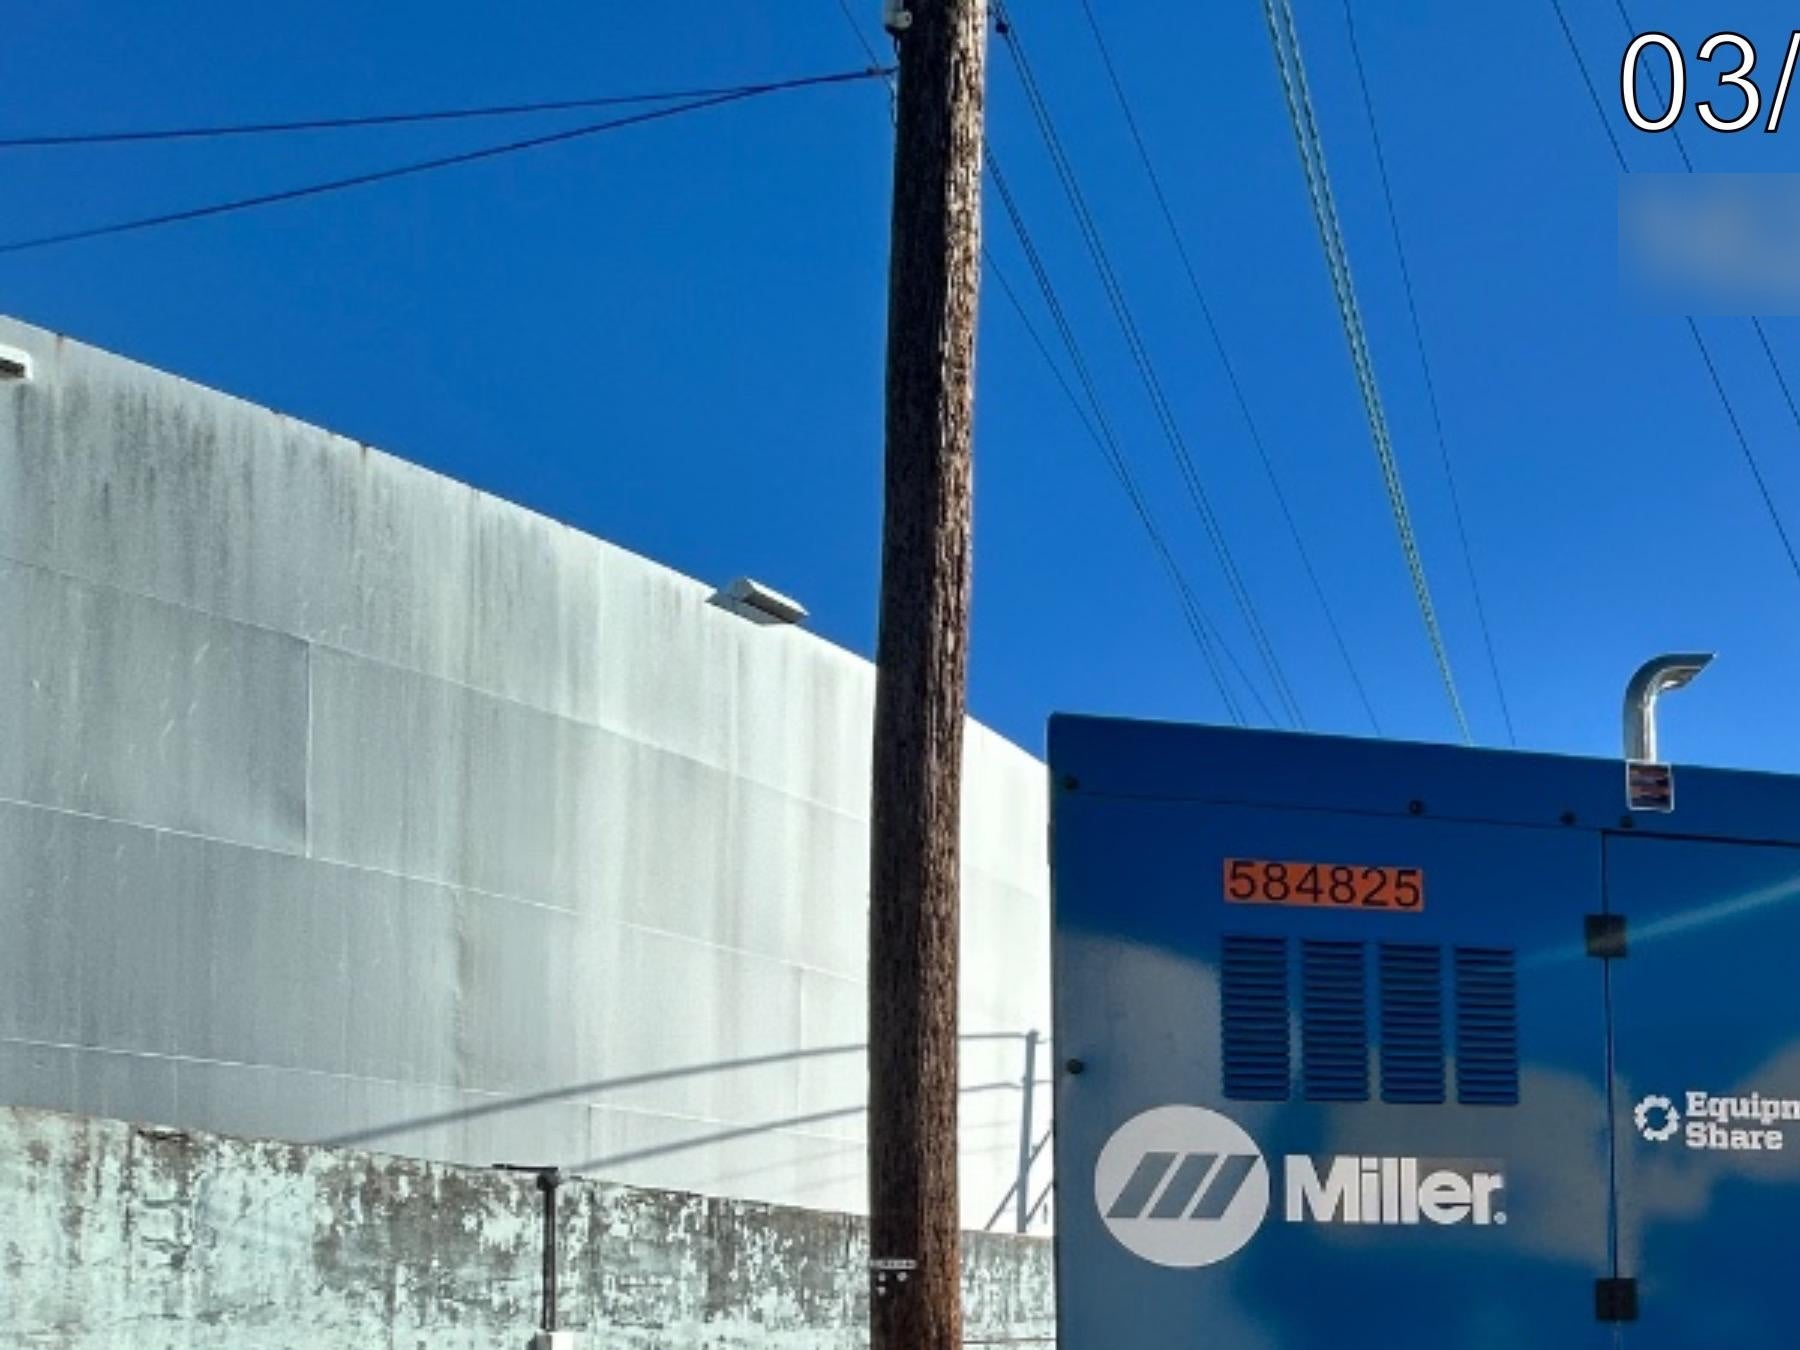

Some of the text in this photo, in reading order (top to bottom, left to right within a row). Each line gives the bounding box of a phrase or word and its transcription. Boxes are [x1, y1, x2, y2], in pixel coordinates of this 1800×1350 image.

[1229, 860, 1422, 908] 584825
[1685, 1121, 1783, 1149] Share
[1284, 1154, 1506, 1225] Miller
